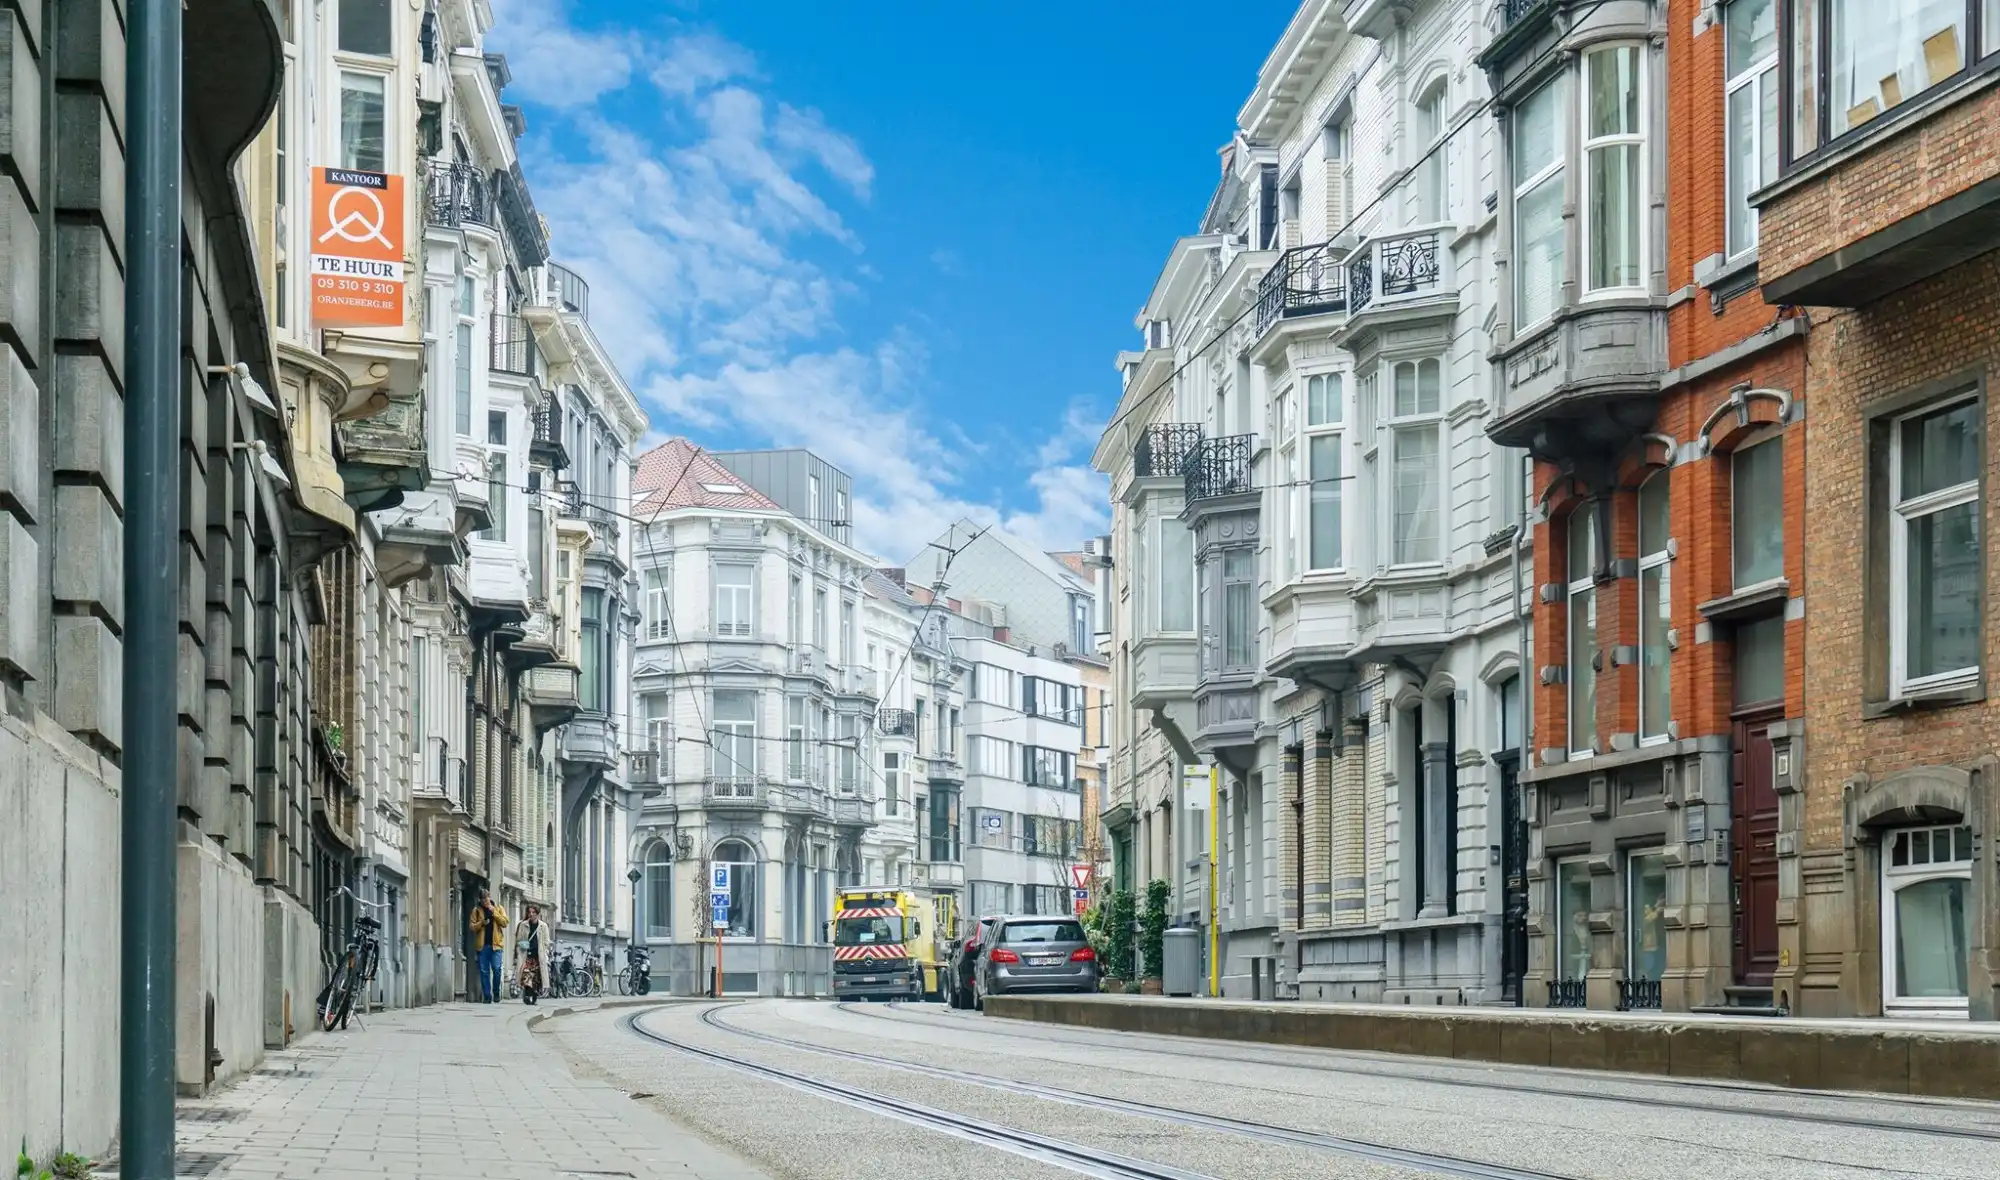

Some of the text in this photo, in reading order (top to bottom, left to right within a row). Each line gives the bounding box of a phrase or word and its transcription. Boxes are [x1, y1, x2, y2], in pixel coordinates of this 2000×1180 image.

[331, 172, 381, 185] KANTOOR
[318, 257, 394, 277] TE HUUR
[318, 278, 395, 294] 09 310 9 310
[318, 296, 394, 309] ORANJEBERG.BE
[717, 870, 724, 881] P
